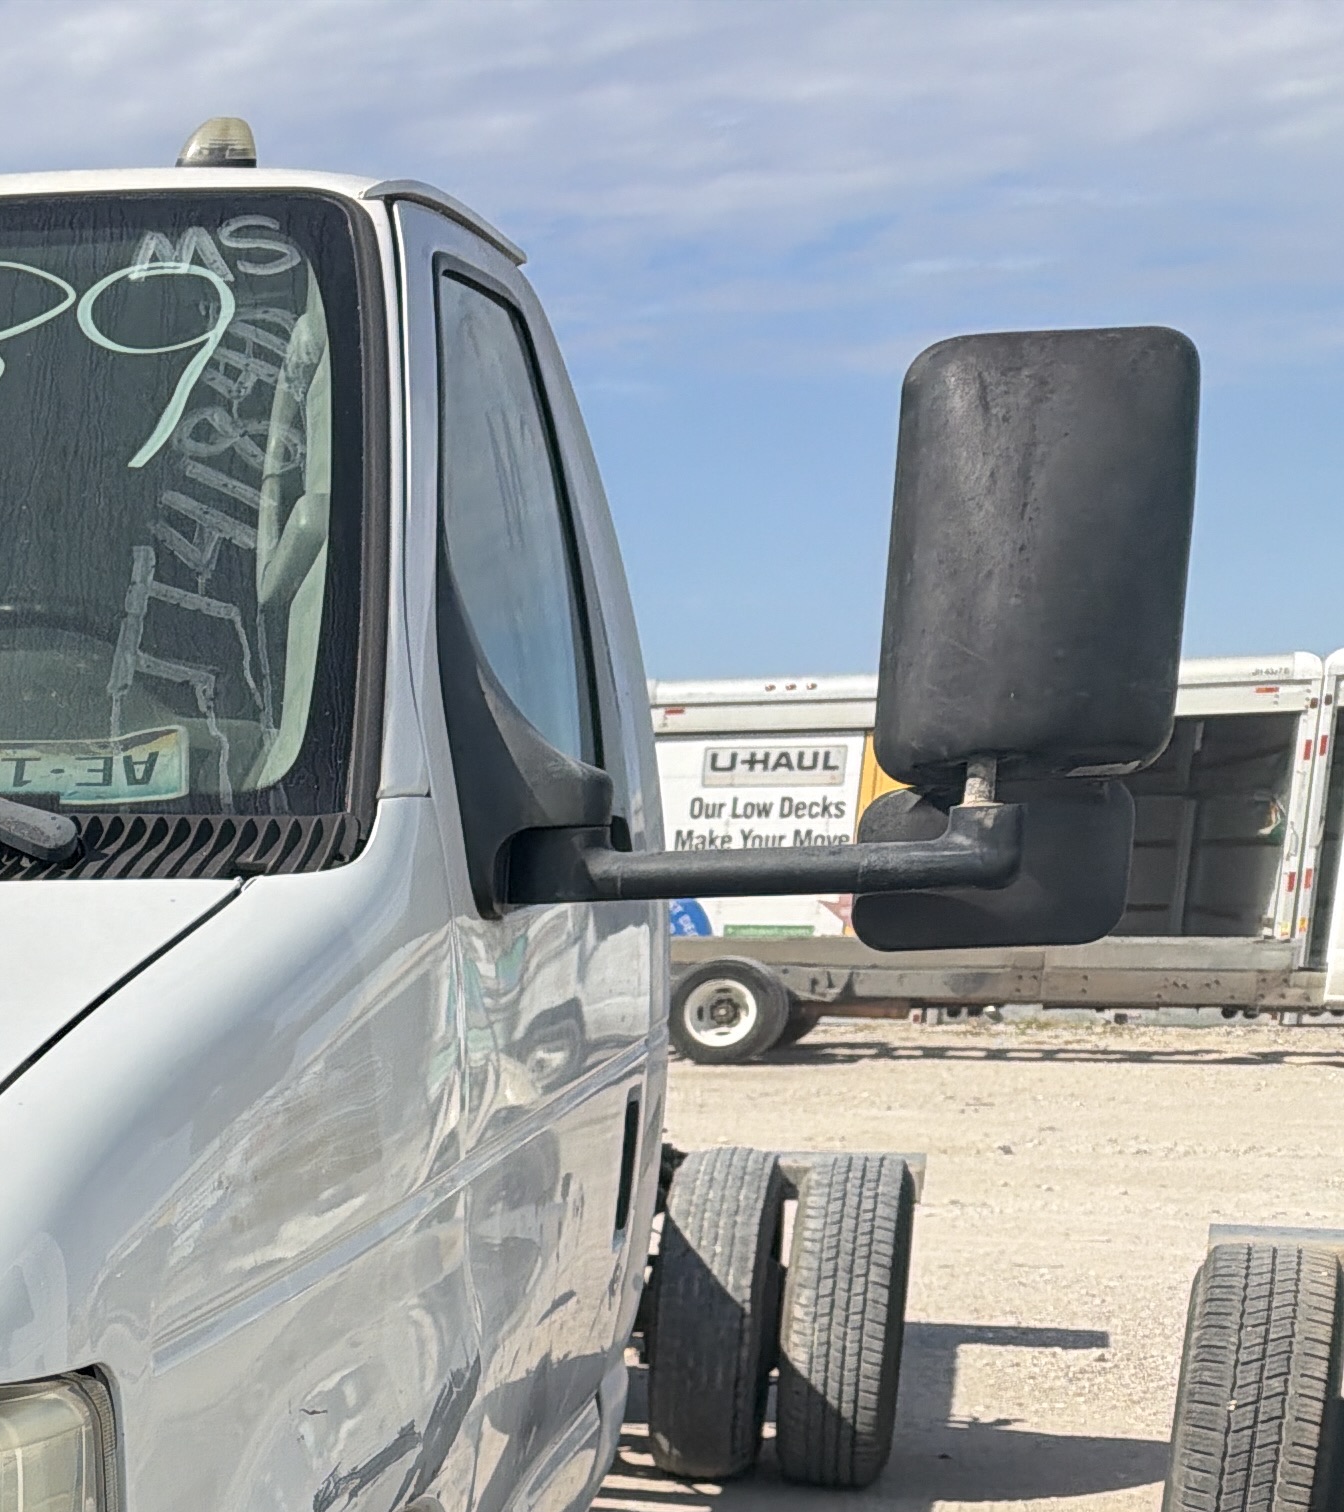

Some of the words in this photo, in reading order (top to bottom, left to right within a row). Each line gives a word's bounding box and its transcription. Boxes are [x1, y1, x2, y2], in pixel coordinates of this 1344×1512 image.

[710, 750, 840, 772] U-HAUL
[689, 796, 727, 820] Our
[731, 796, 774, 820] Low
[778, 795, 847, 820] Decks
[674, 829, 733, 851] Make
[740, 828, 787, 849] Your
[792, 829, 850, 848] Move
